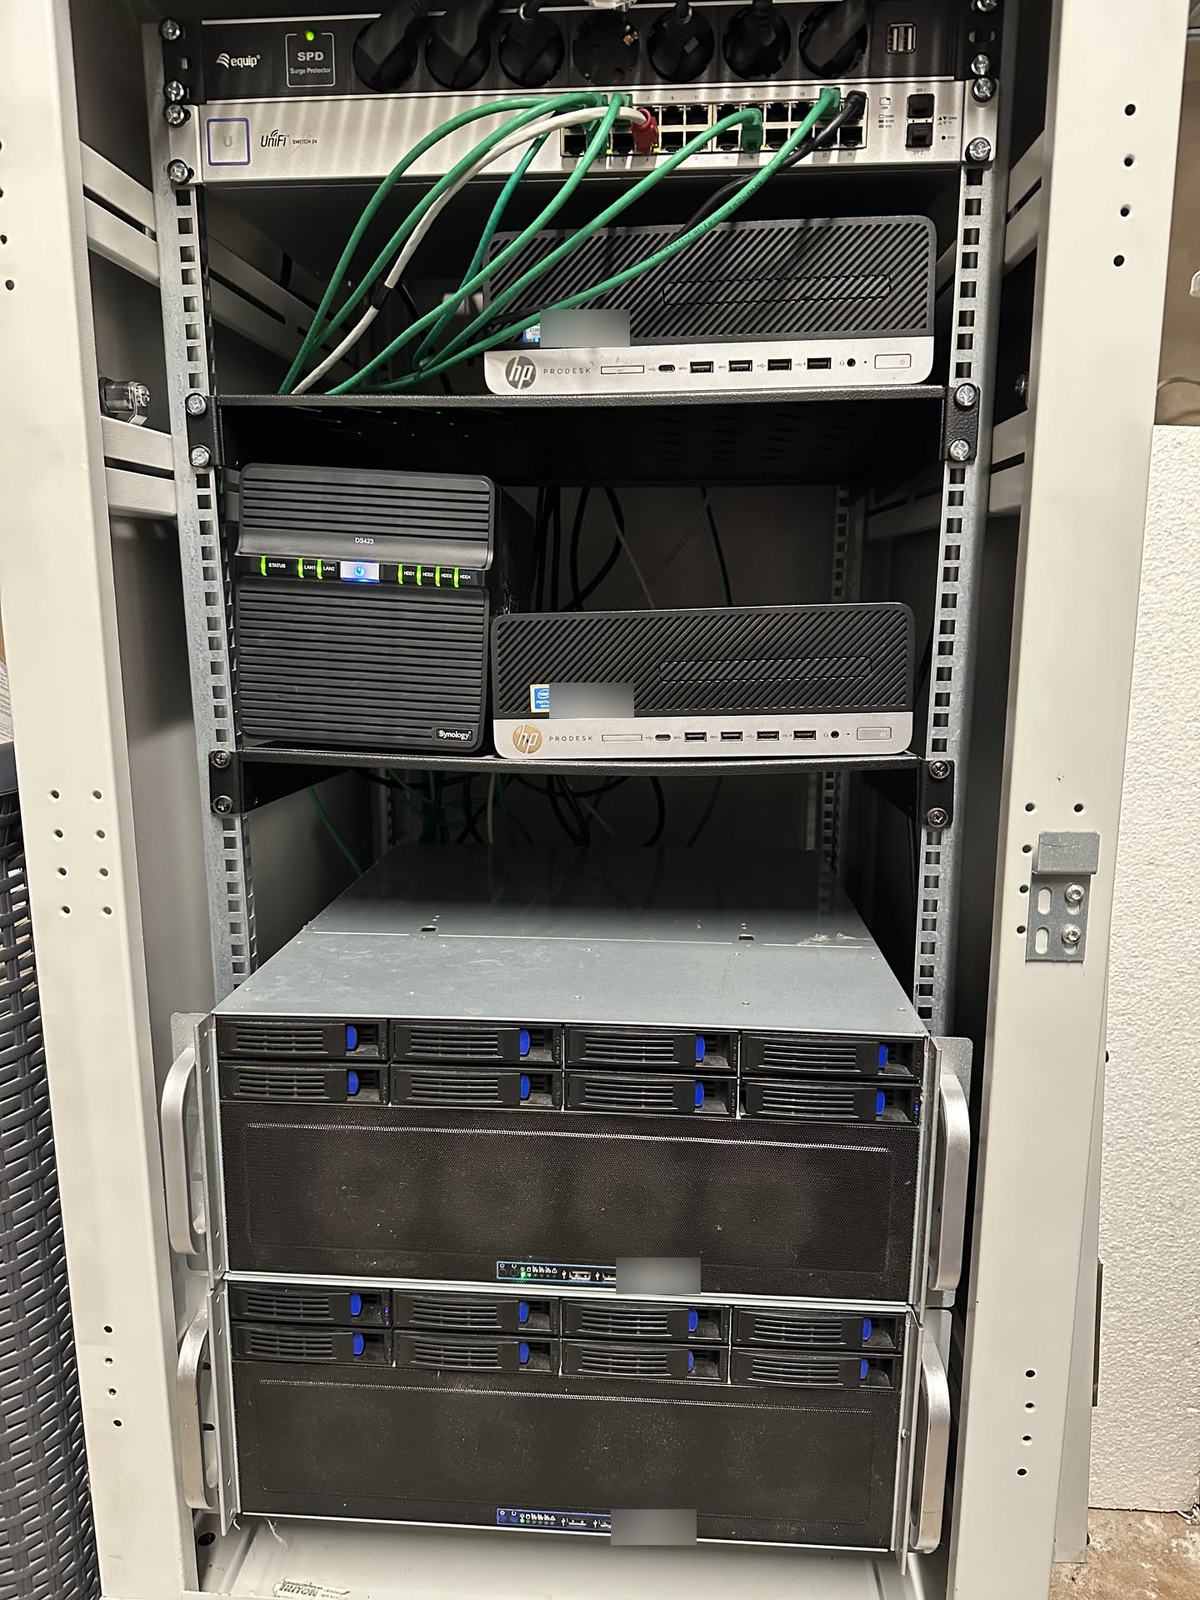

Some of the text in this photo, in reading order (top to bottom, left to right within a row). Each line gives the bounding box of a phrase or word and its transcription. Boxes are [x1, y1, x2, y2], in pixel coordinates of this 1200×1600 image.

[297, 51, 324, 61] SPD
[289, 67, 306, 75] Surge
[260, 131, 287, 148] UniFi
[507, 356, 591, 390] hp PRODESK
[355, 537, 374, 545] DS423
[438, 730, 470, 741] Synology
[515, 724, 540, 754] hp
